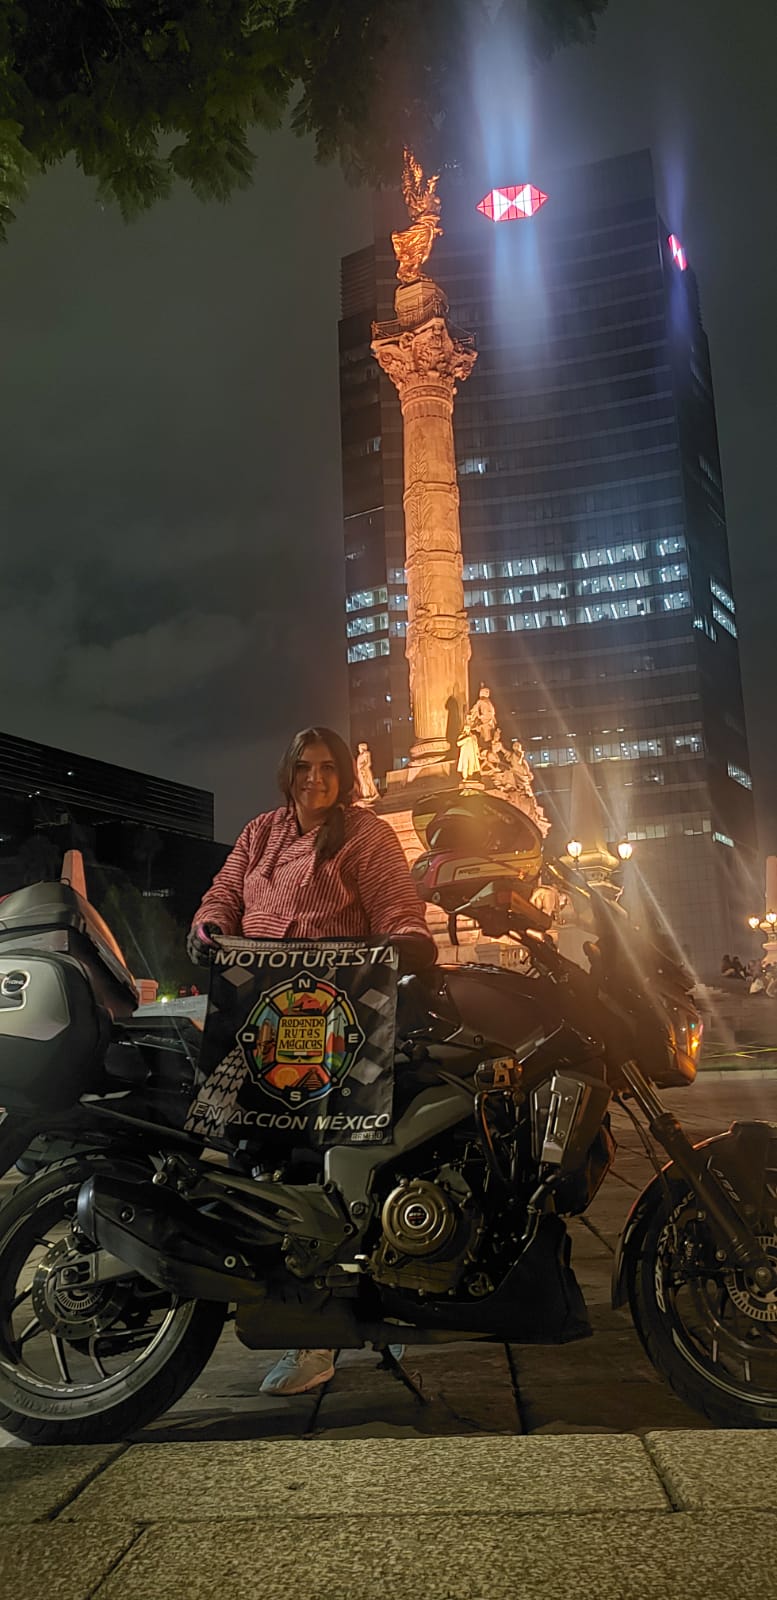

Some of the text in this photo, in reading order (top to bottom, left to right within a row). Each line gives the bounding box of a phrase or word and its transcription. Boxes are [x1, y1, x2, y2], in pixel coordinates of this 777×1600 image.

[215, 946, 395, 968] MOTOTURISTA
[299, 979, 311, 988] N
[242, 1033, 254, 1042] O
[348, 1033, 359, 1043] E
[290, 1091, 301, 1101] S
[191, 1102, 391, 1130] EN ACCIÓN MÉXICO
